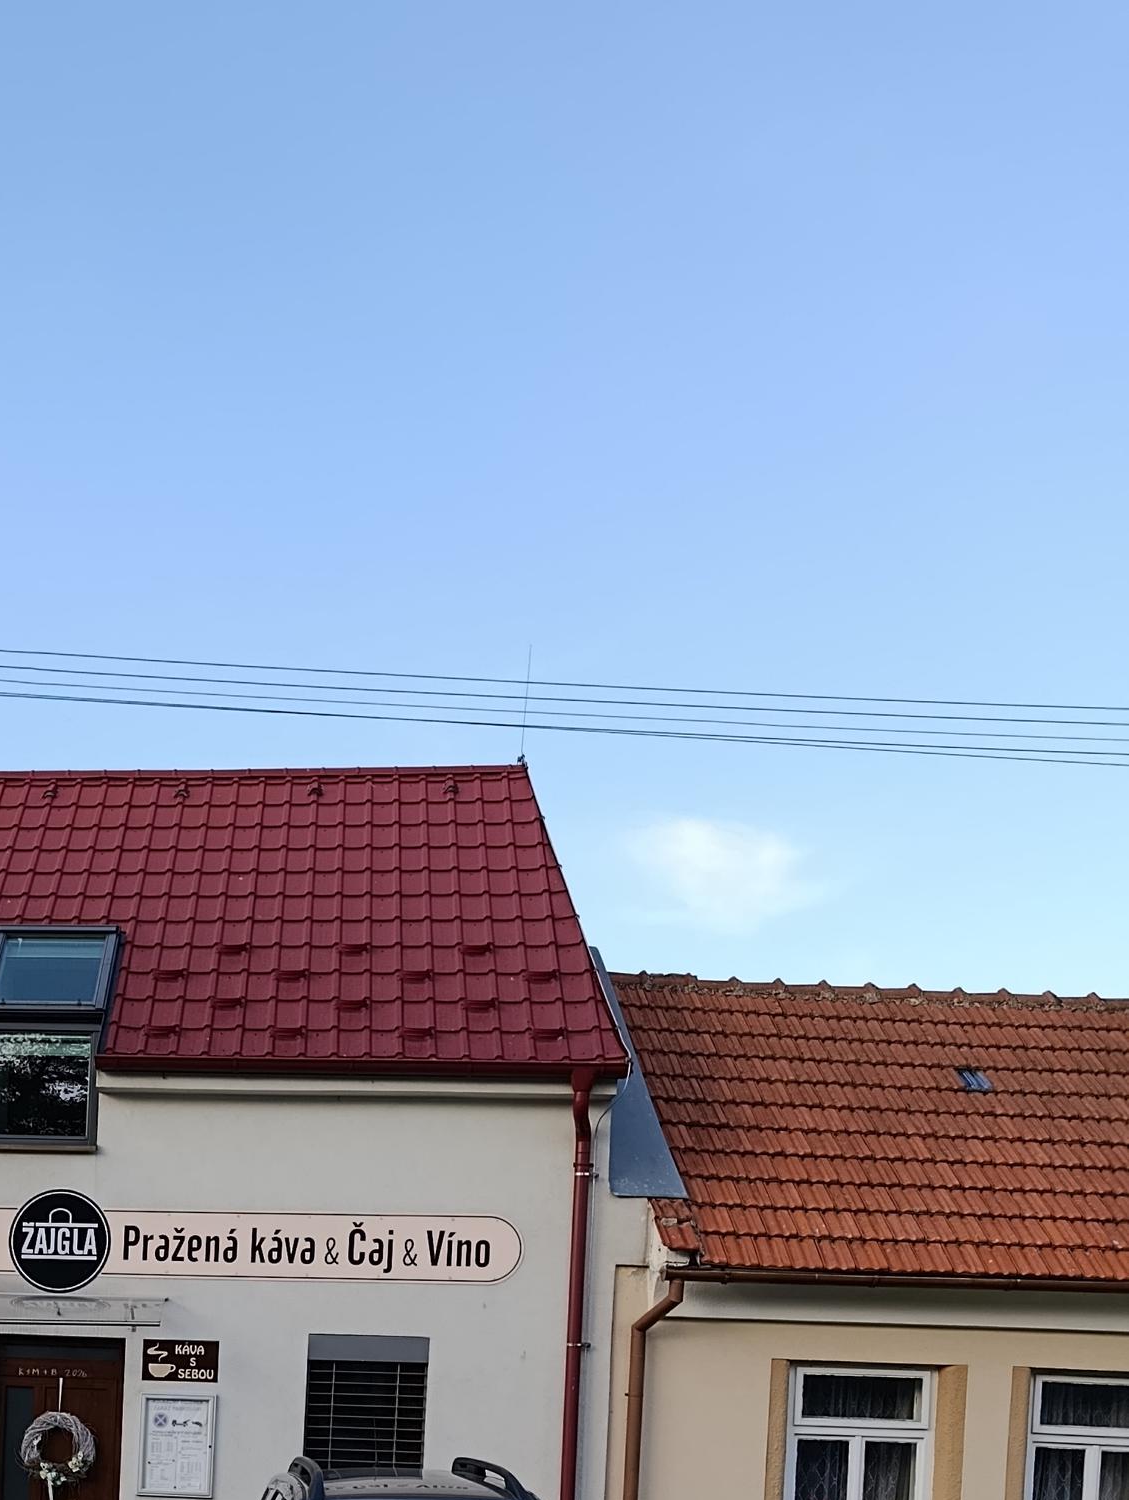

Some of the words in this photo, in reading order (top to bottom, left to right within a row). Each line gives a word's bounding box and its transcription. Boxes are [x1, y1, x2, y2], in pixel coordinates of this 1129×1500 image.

[21, 1222, 98, 1256] ŽAJGLA
[122, 1224, 238, 1263] Pražená
[250, 1227, 316, 1264] káva
[324, 1237, 340, 1264] &
[347, 1222, 394, 1273] Čaj
[402, 1238, 418, 1267] &
[426, 1230, 491, 1268] Víno
[174, 1342, 205, 1356] KÁVA
[189, 1357, 197, 1367] S
[177, 1368, 215, 1381] SEBOU
